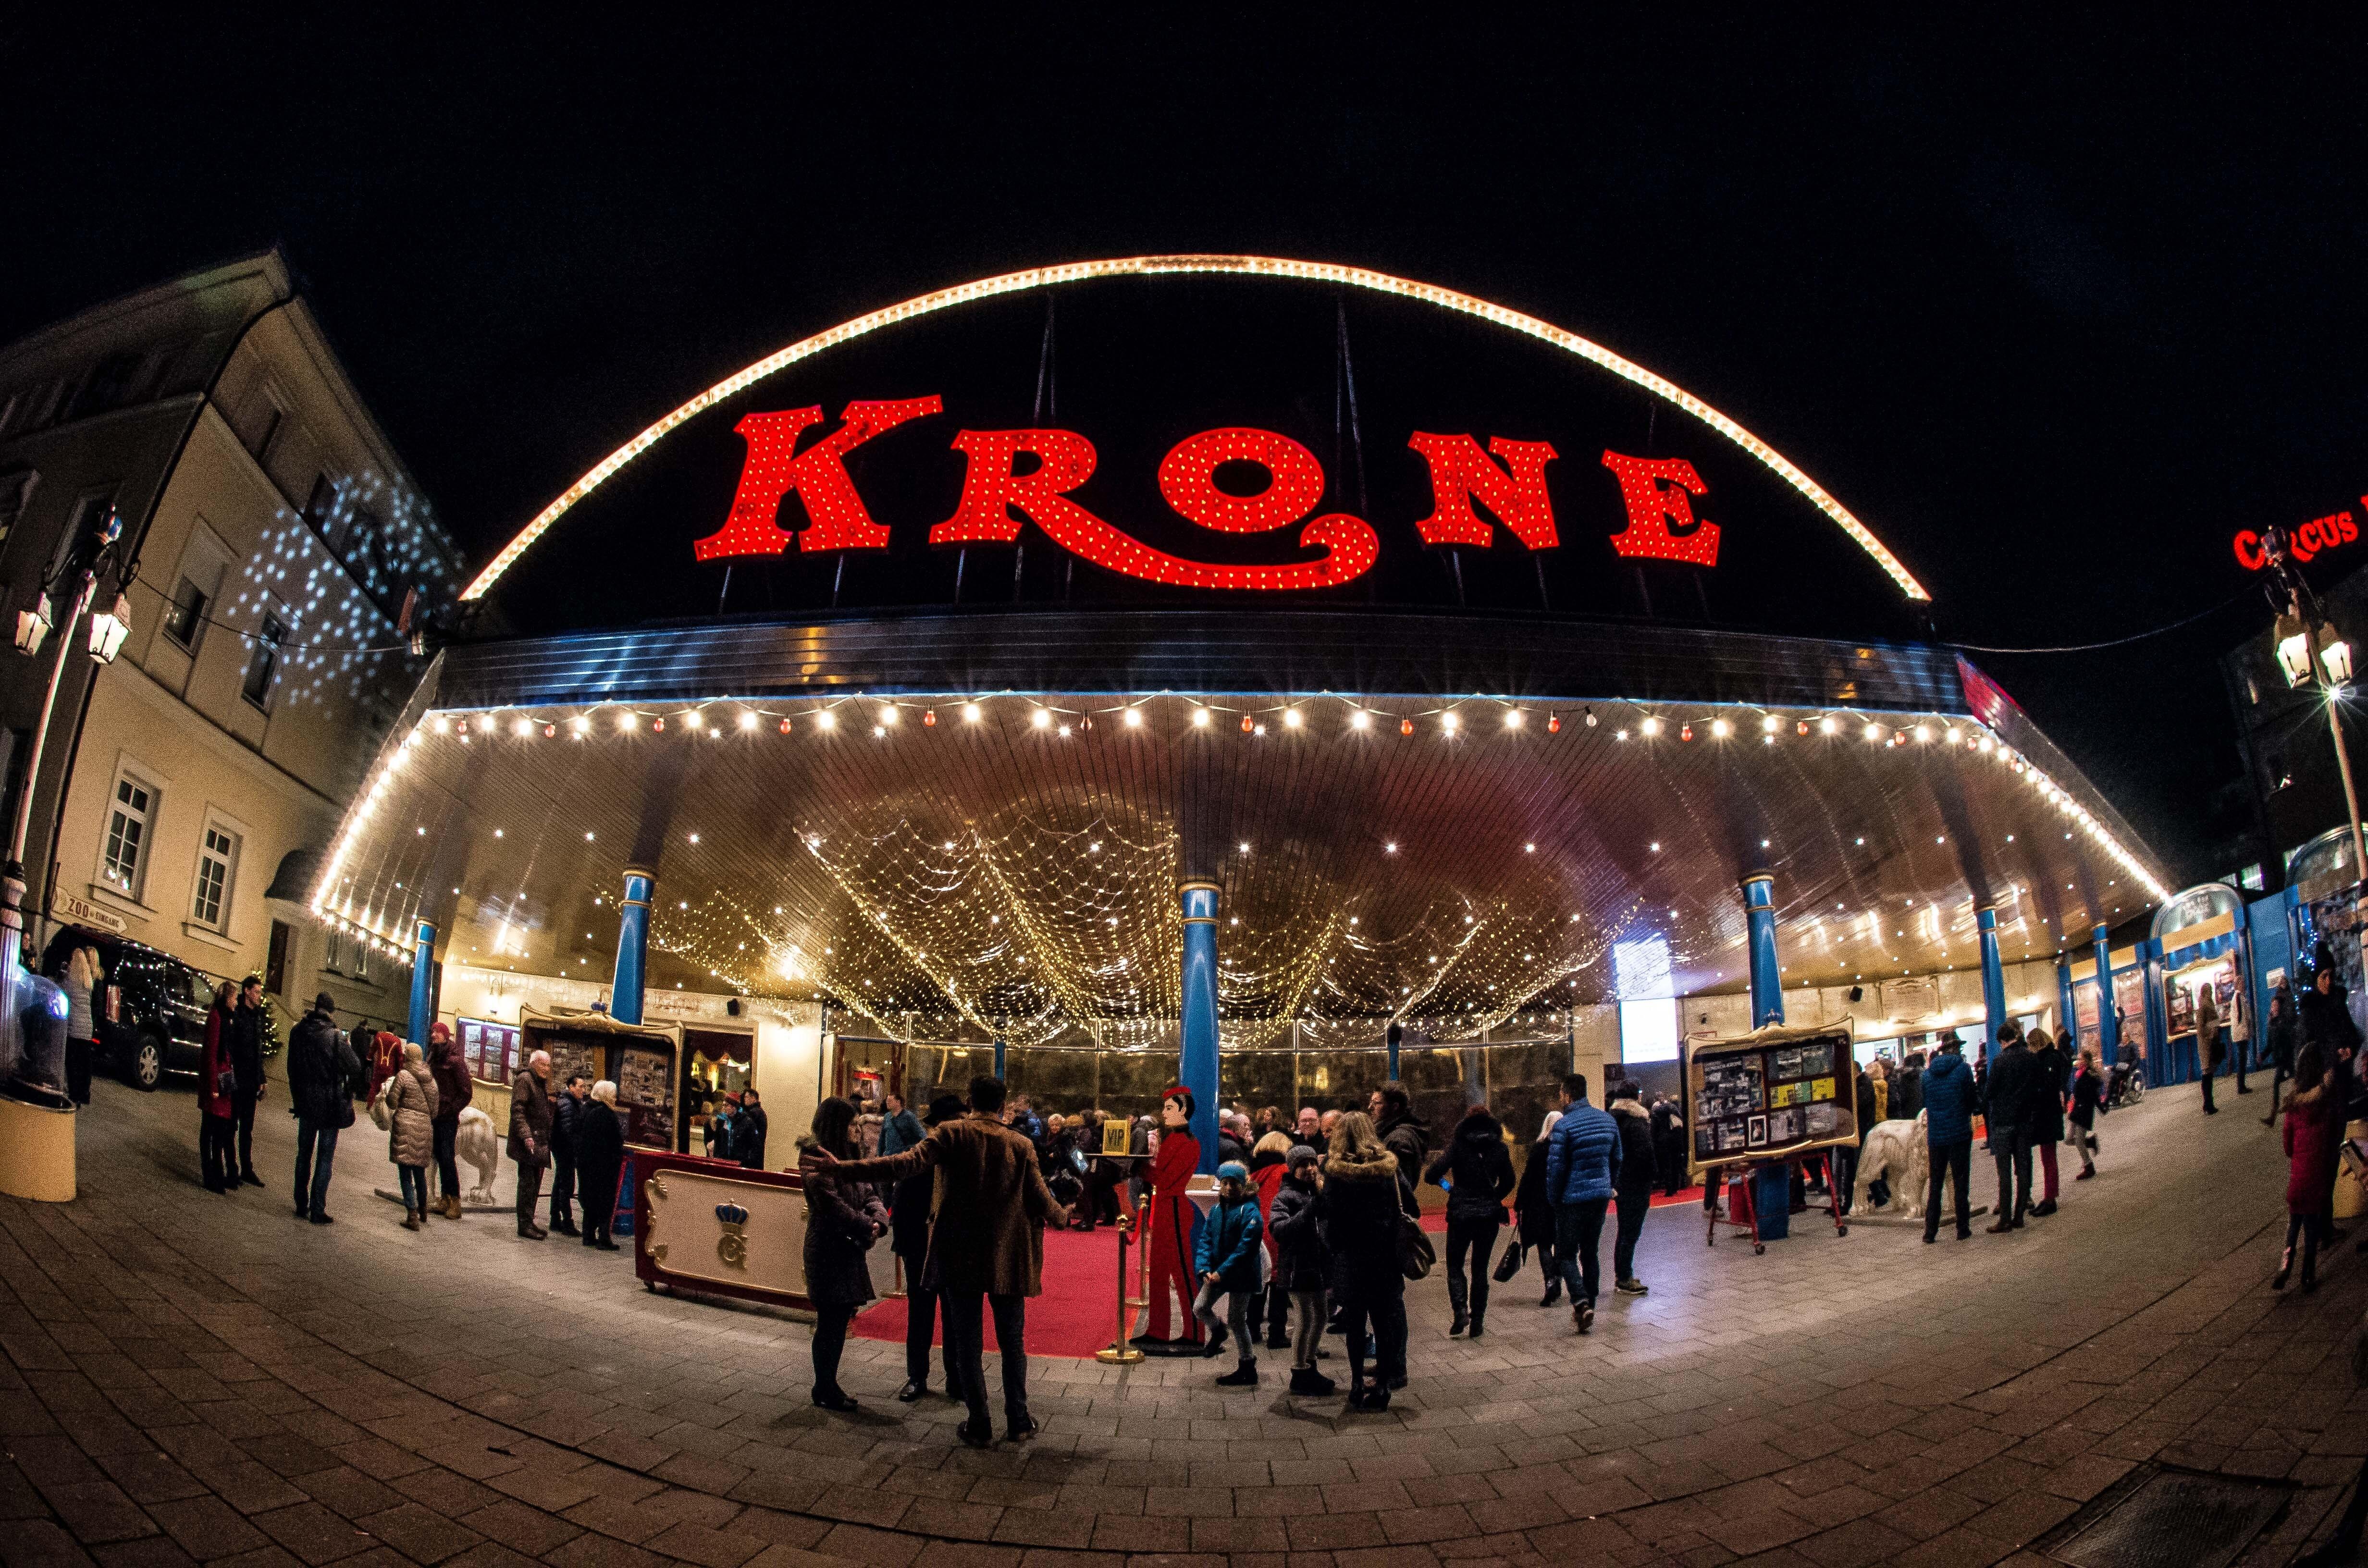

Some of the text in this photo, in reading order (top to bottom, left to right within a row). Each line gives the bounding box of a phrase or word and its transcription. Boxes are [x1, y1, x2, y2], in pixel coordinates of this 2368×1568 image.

[694, 395, 1720, 590] KRONE
[2234, 512, 2358, 570] CCUS
[69, 898, 89, 918] ZOO
[1107, 1128, 1124, 1146] VIP
